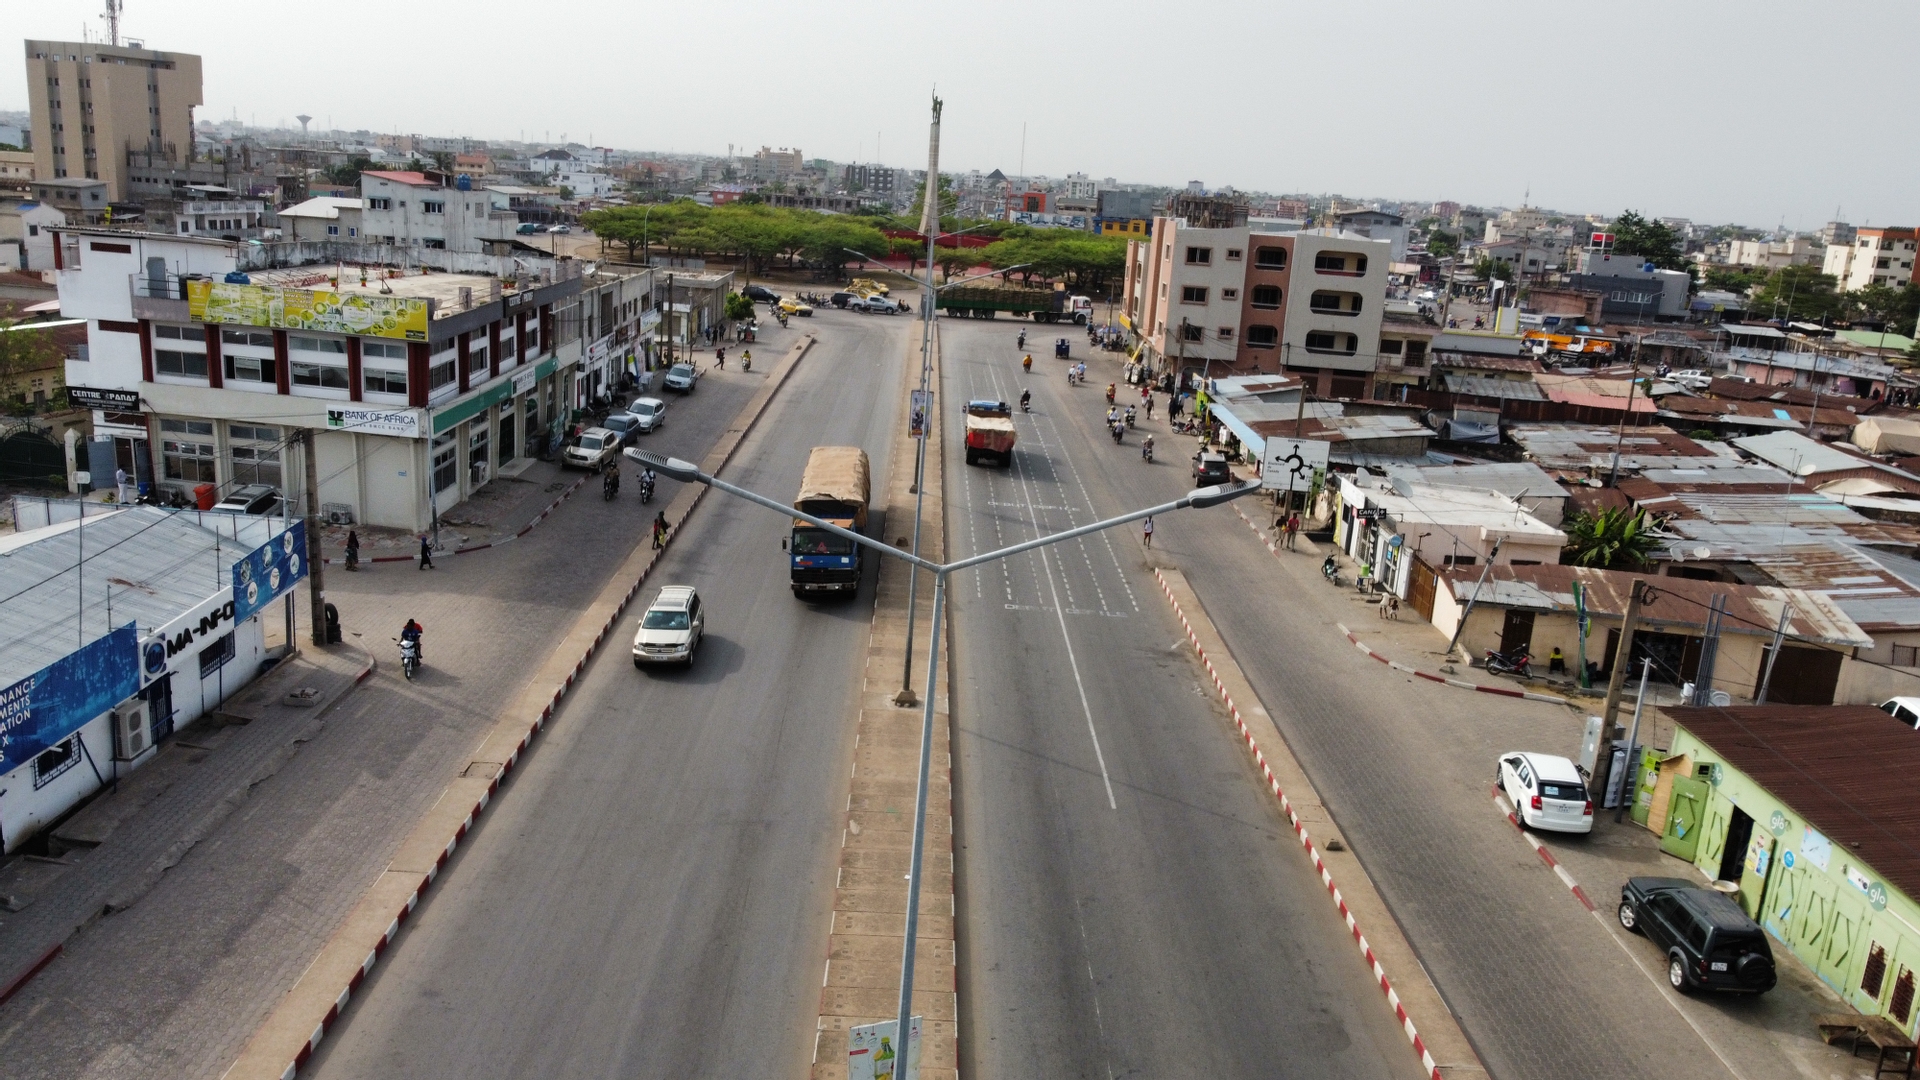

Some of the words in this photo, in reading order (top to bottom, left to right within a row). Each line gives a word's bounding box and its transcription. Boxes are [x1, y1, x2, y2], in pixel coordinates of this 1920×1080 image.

[71, 389, 101, 398] CENTRE
[344, 410, 369, 421] BANK
[370, 413, 382, 421] OF
[384, 414, 416, 425] AFRICA
[167, 600, 235, 658] MA-INFO
[1771, 815, 1785, 829] glo
[1869, 888, 1886, 904] glo
